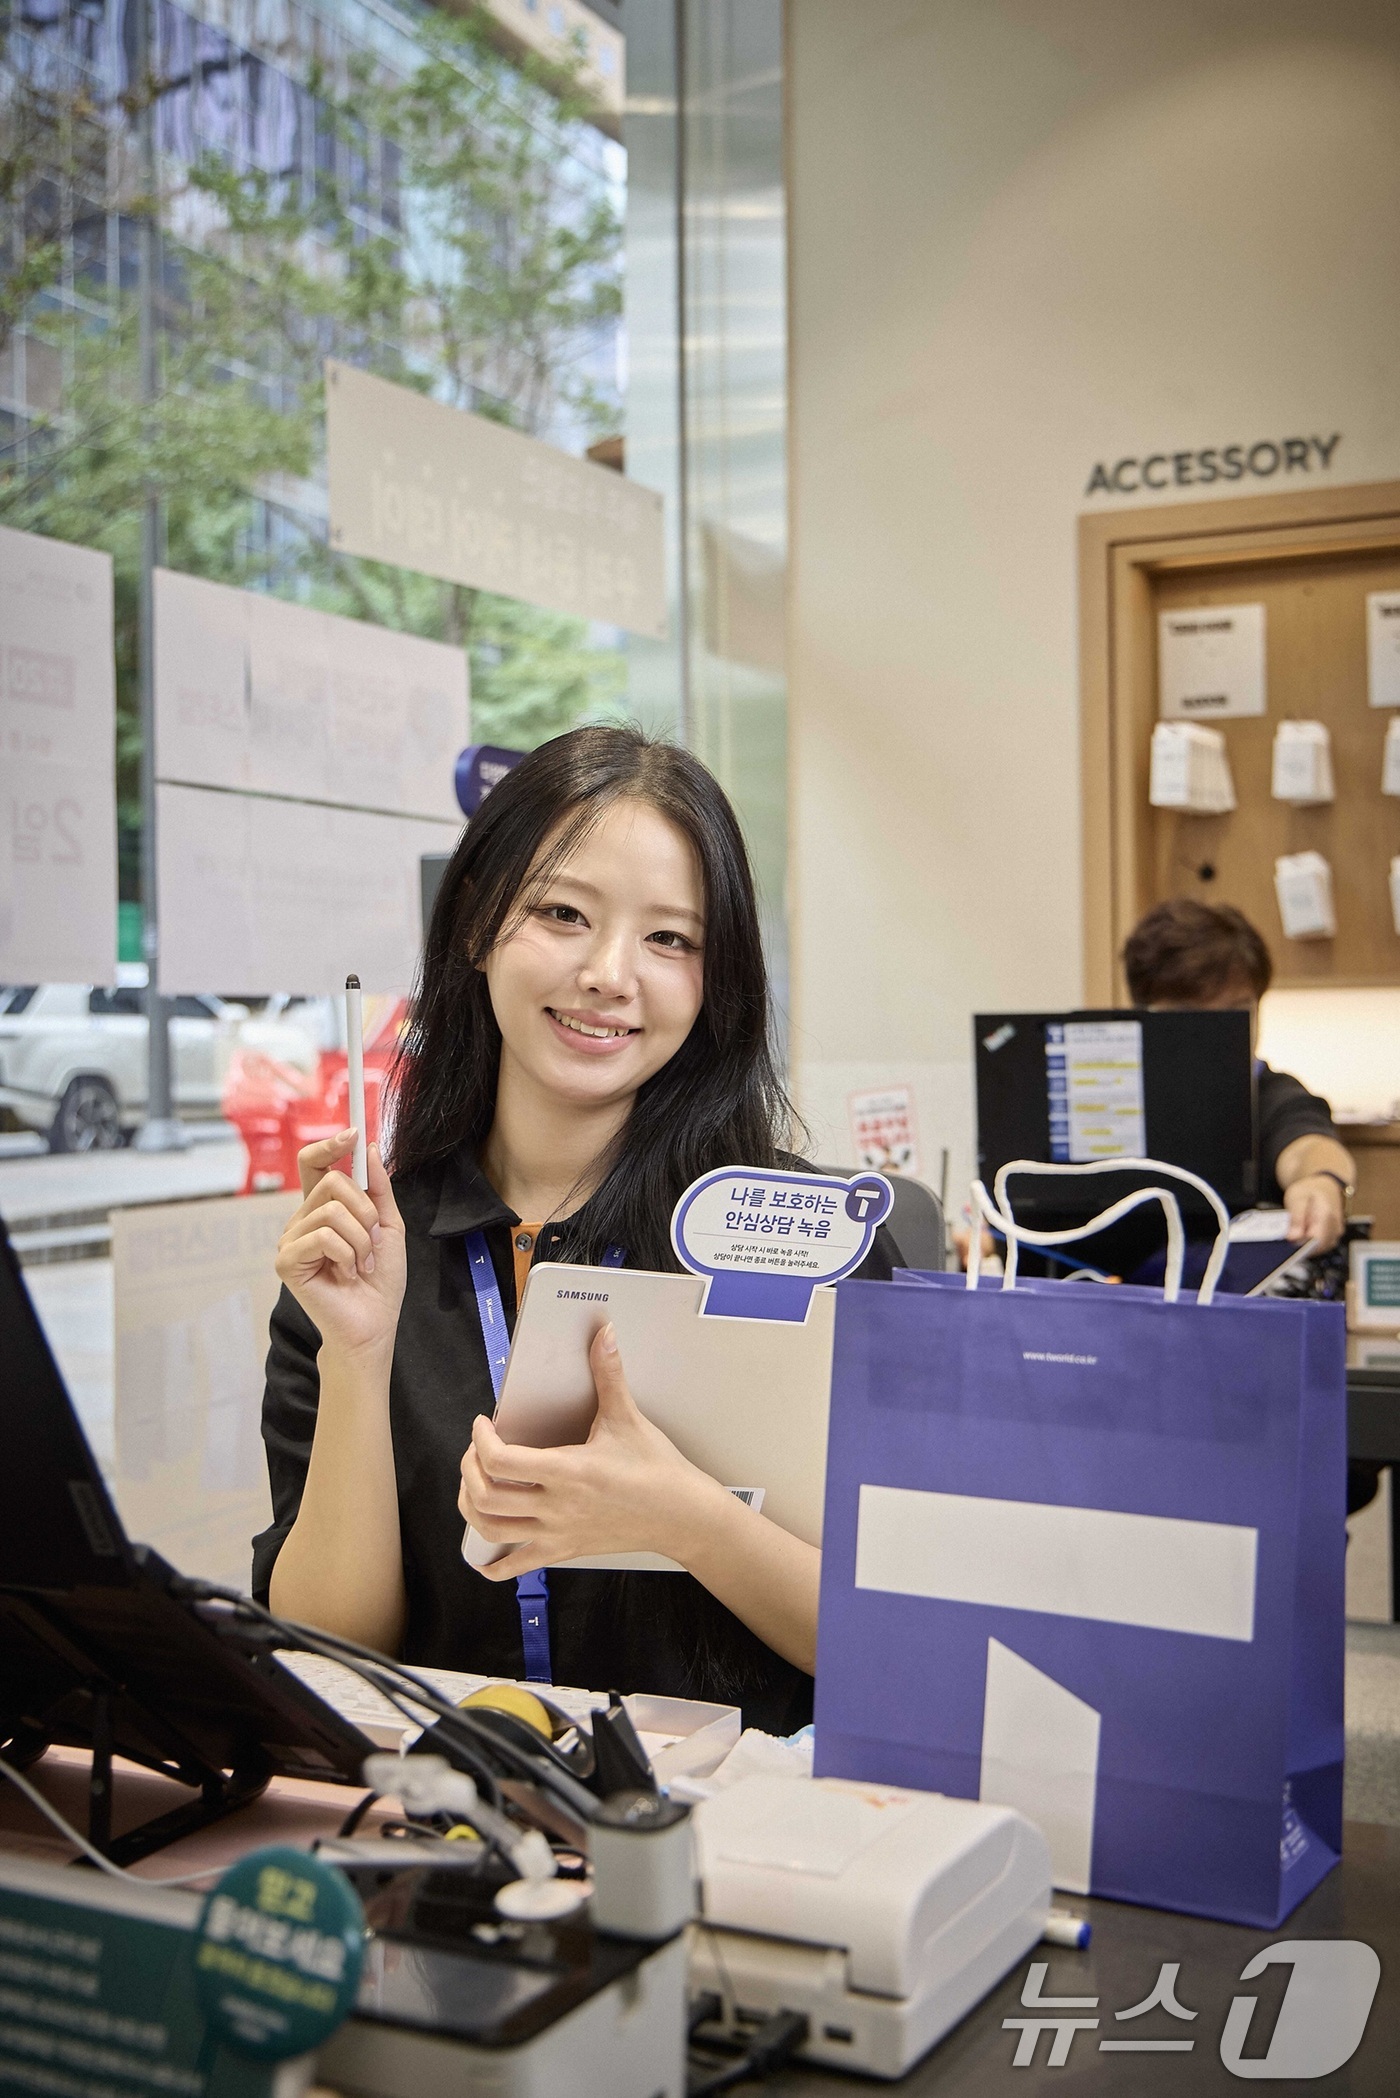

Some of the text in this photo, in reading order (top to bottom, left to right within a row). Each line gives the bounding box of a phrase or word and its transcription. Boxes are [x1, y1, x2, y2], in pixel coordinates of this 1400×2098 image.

[1084, 434, 1341, 498] ACCESSORY
[730, 1186, 838, 1215] 나를 보호하는
[854, 1188, 881, 1218] T
[725, 1211, 832, 1239] 안심상담 녹음
[713, 1252, 820, 1269] 상담이 끝나면 종료 버튼을 눌러주세요.
[730, 1243, 810, 1258] 상담 시작 시 바로 녹음 시작!
[556, 1289, 610, 1303] SAMSUNG
[1022, 1350, 1098, 1366] www.tworld.co.kr
[855, 1484, 1258, 1895] T
